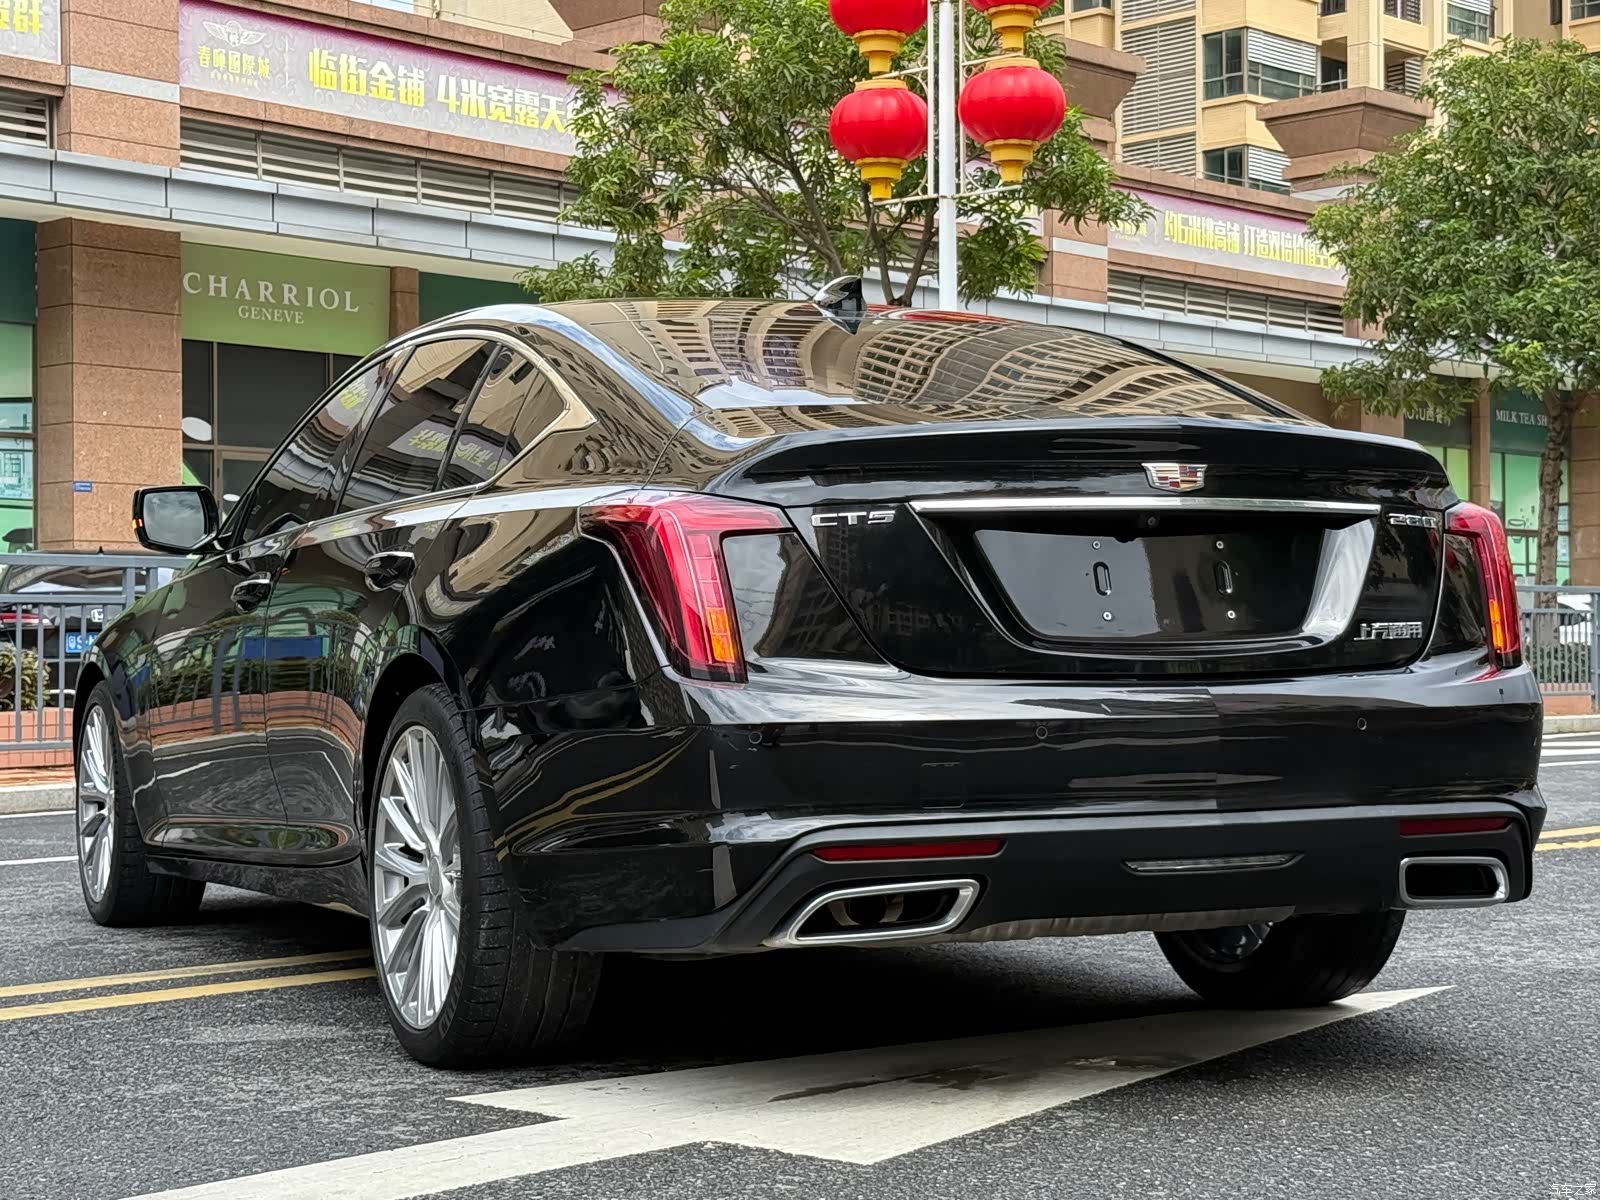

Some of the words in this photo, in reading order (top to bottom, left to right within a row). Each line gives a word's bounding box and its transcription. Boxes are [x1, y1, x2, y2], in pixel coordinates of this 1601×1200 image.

[308, 47, 425, 107] 临街金铺
[182, 272, 359, 313] CHARRIOL
[238, 305, 304, 324] GENEVE
[1496, 409, 1518, 423] MILK
[1519, 412, 1535, 425] TEA
[811, 510, 896, 526] CT5
[1354, 621, 1422, 641] 上汽通用
